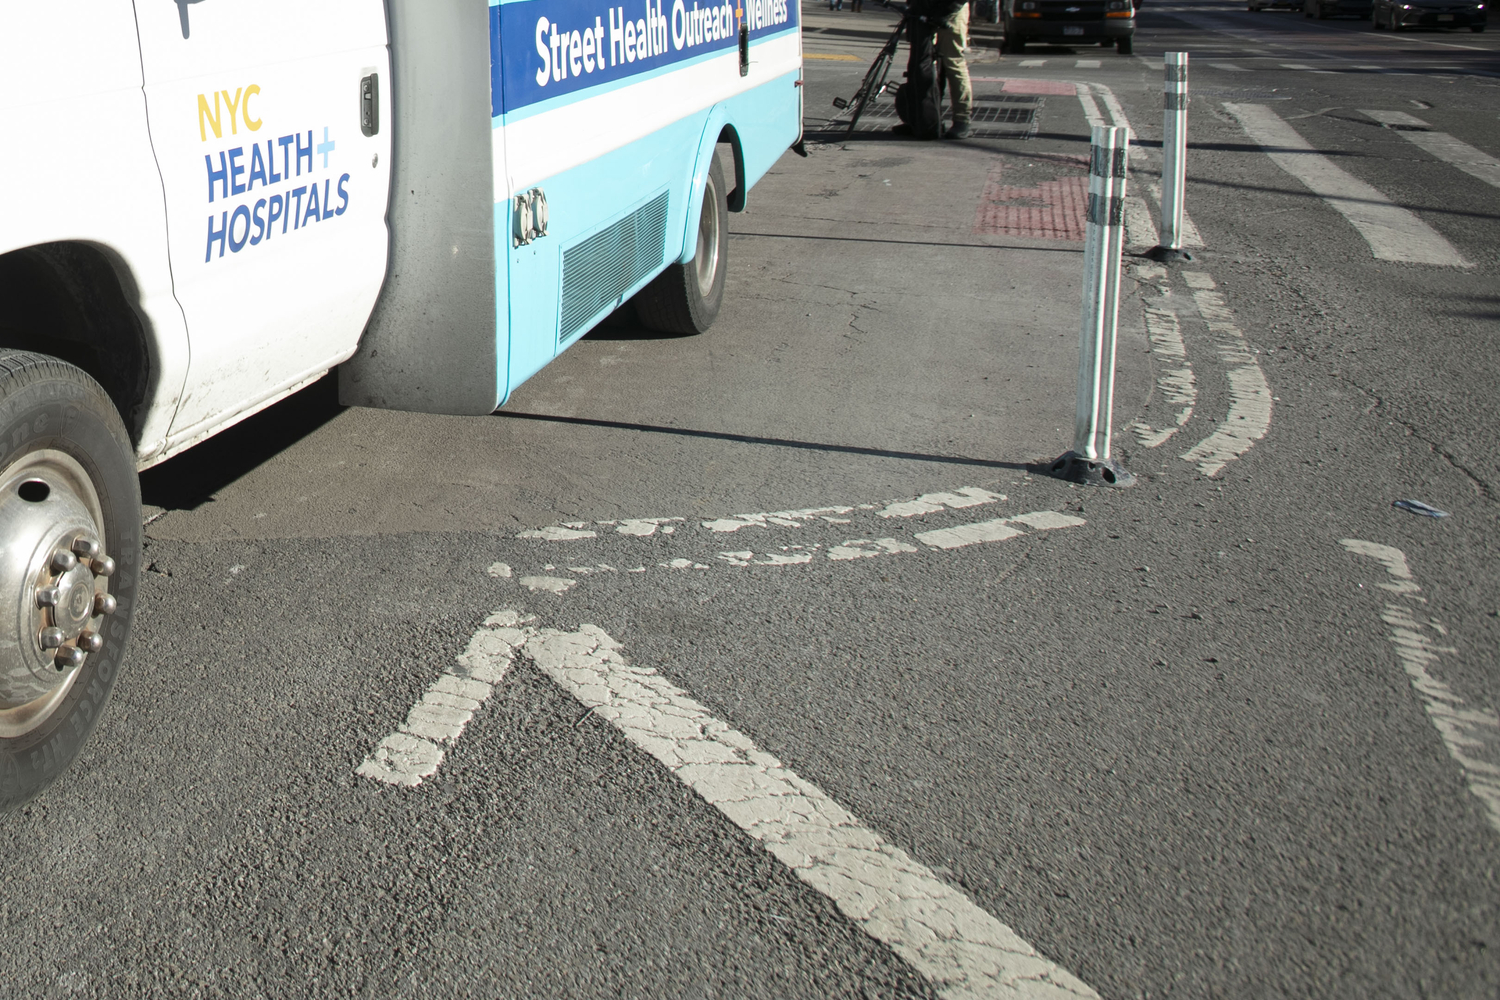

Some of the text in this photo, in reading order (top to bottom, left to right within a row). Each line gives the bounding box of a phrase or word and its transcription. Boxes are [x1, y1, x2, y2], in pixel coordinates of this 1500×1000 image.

[535, 16, 605, 87] Street
[197, 83, 263, 142] NYC
[204, 173, 350, 263] HOSPITALS
[69, 526, 134, 738] TRANSFORCE
